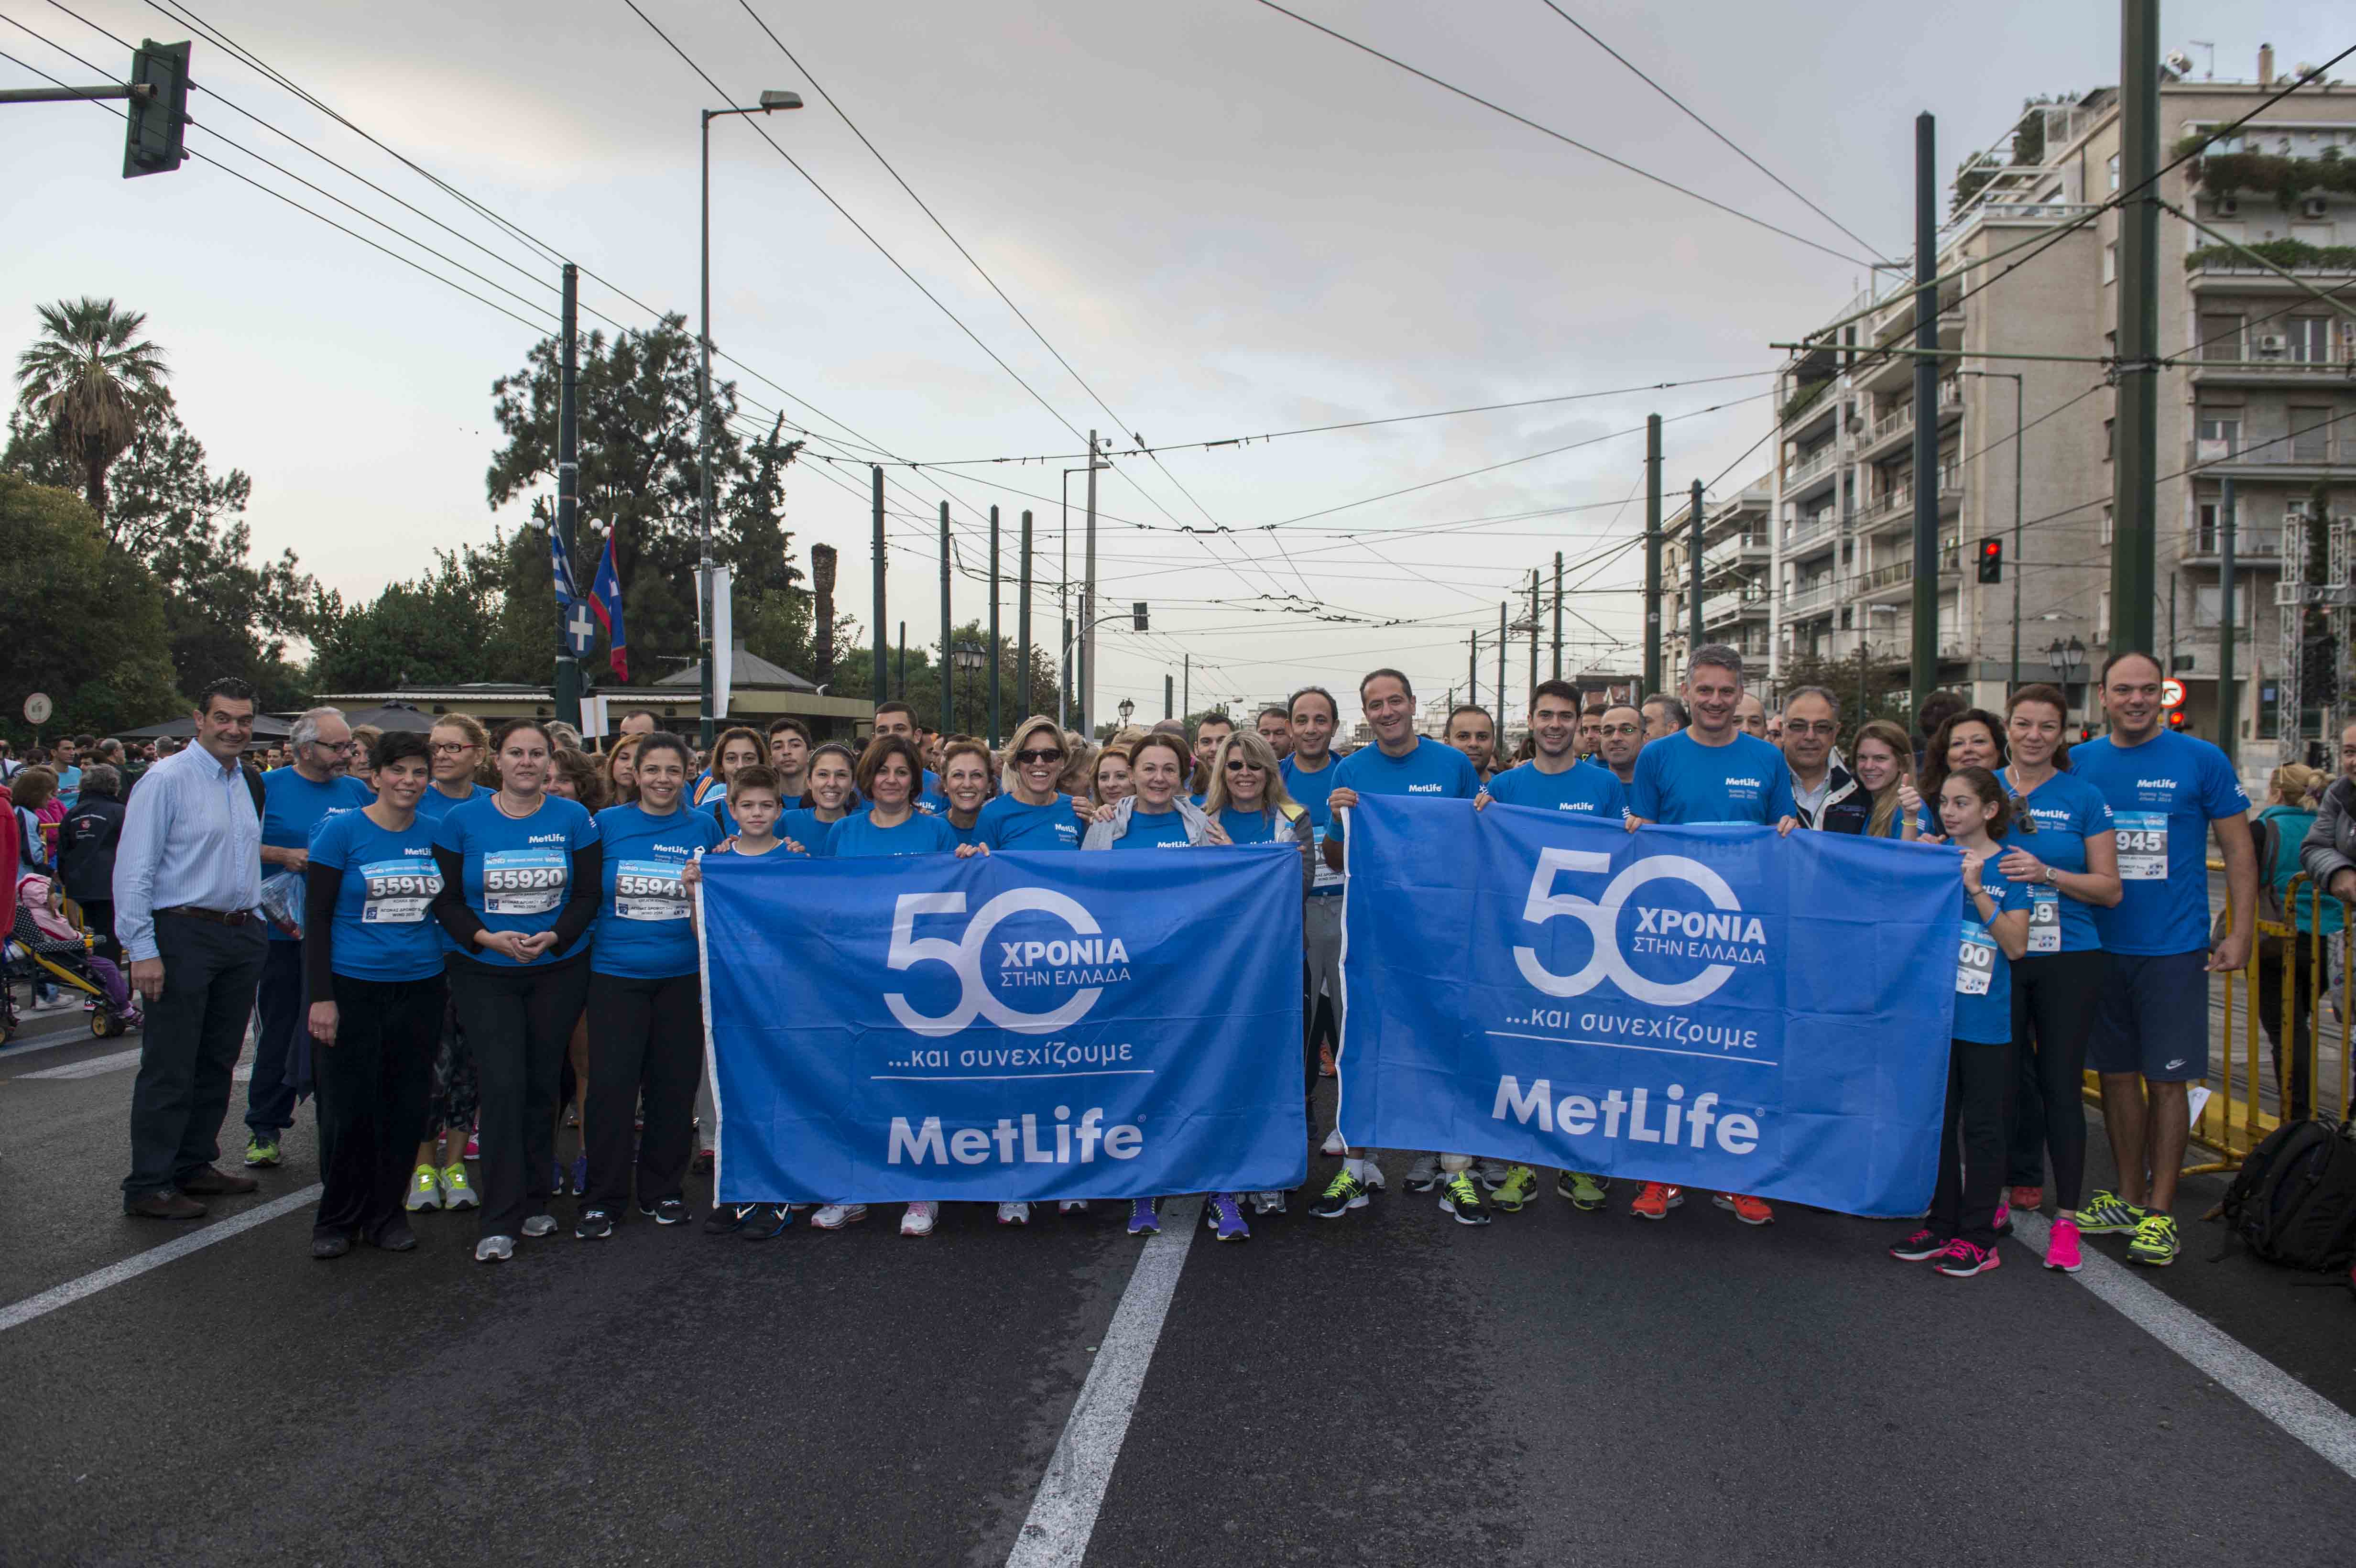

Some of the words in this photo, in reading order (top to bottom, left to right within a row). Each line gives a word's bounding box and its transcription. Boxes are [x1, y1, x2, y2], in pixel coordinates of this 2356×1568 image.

[1408, 784, 1441, 792] MetLife
[1725, 778, 1760, 787] MetLife
[2137, 779, 2177, 788] MetLife
[1560, 803, 1594, 811] MetLife
[2029, 809, 2071, 820] MetLife
[528, 833, 566, 843] MetLife
[2116, 831, 2161, 852] 945
[653, 843, 689, 855] MetLife
[371, 876, 441, 897] 55919
[488, 869, 563, 890] 55920
[620, 876, 687, 898] 55941
[1513, 847, 1741, 1007] 50
[1636, 907, 1767, 945] ΧΡΟΝΙΑ
[1001, 938, 1130, 968] ΧΡΟΝΙΑ
[1633, 936, 1683, 956] ΣΤΗΝ
[1689, 942, 1766, 964] ΕΛΛΑΔΑ
[1959, 943, 1990, 967] 00
[884, 887, 1103, 1036] 50
[1001, 971, 1049, 987] ΣΤΗΝ
[1055, 967, 1131, 985] ΕΛΛΑΔΑ
[1505, 1009, 1569, 1028] ...και
[1581, 1014, 1757, 1050] συνεχίζουμε
[888, 1051, 949, 1067] ...και
[961, 1041, 1133, 1067] συνεχίζουμε
[1492, 1075, 1759, 1155] MetLife
[888, 1105, 1143, 1165] MetLife
